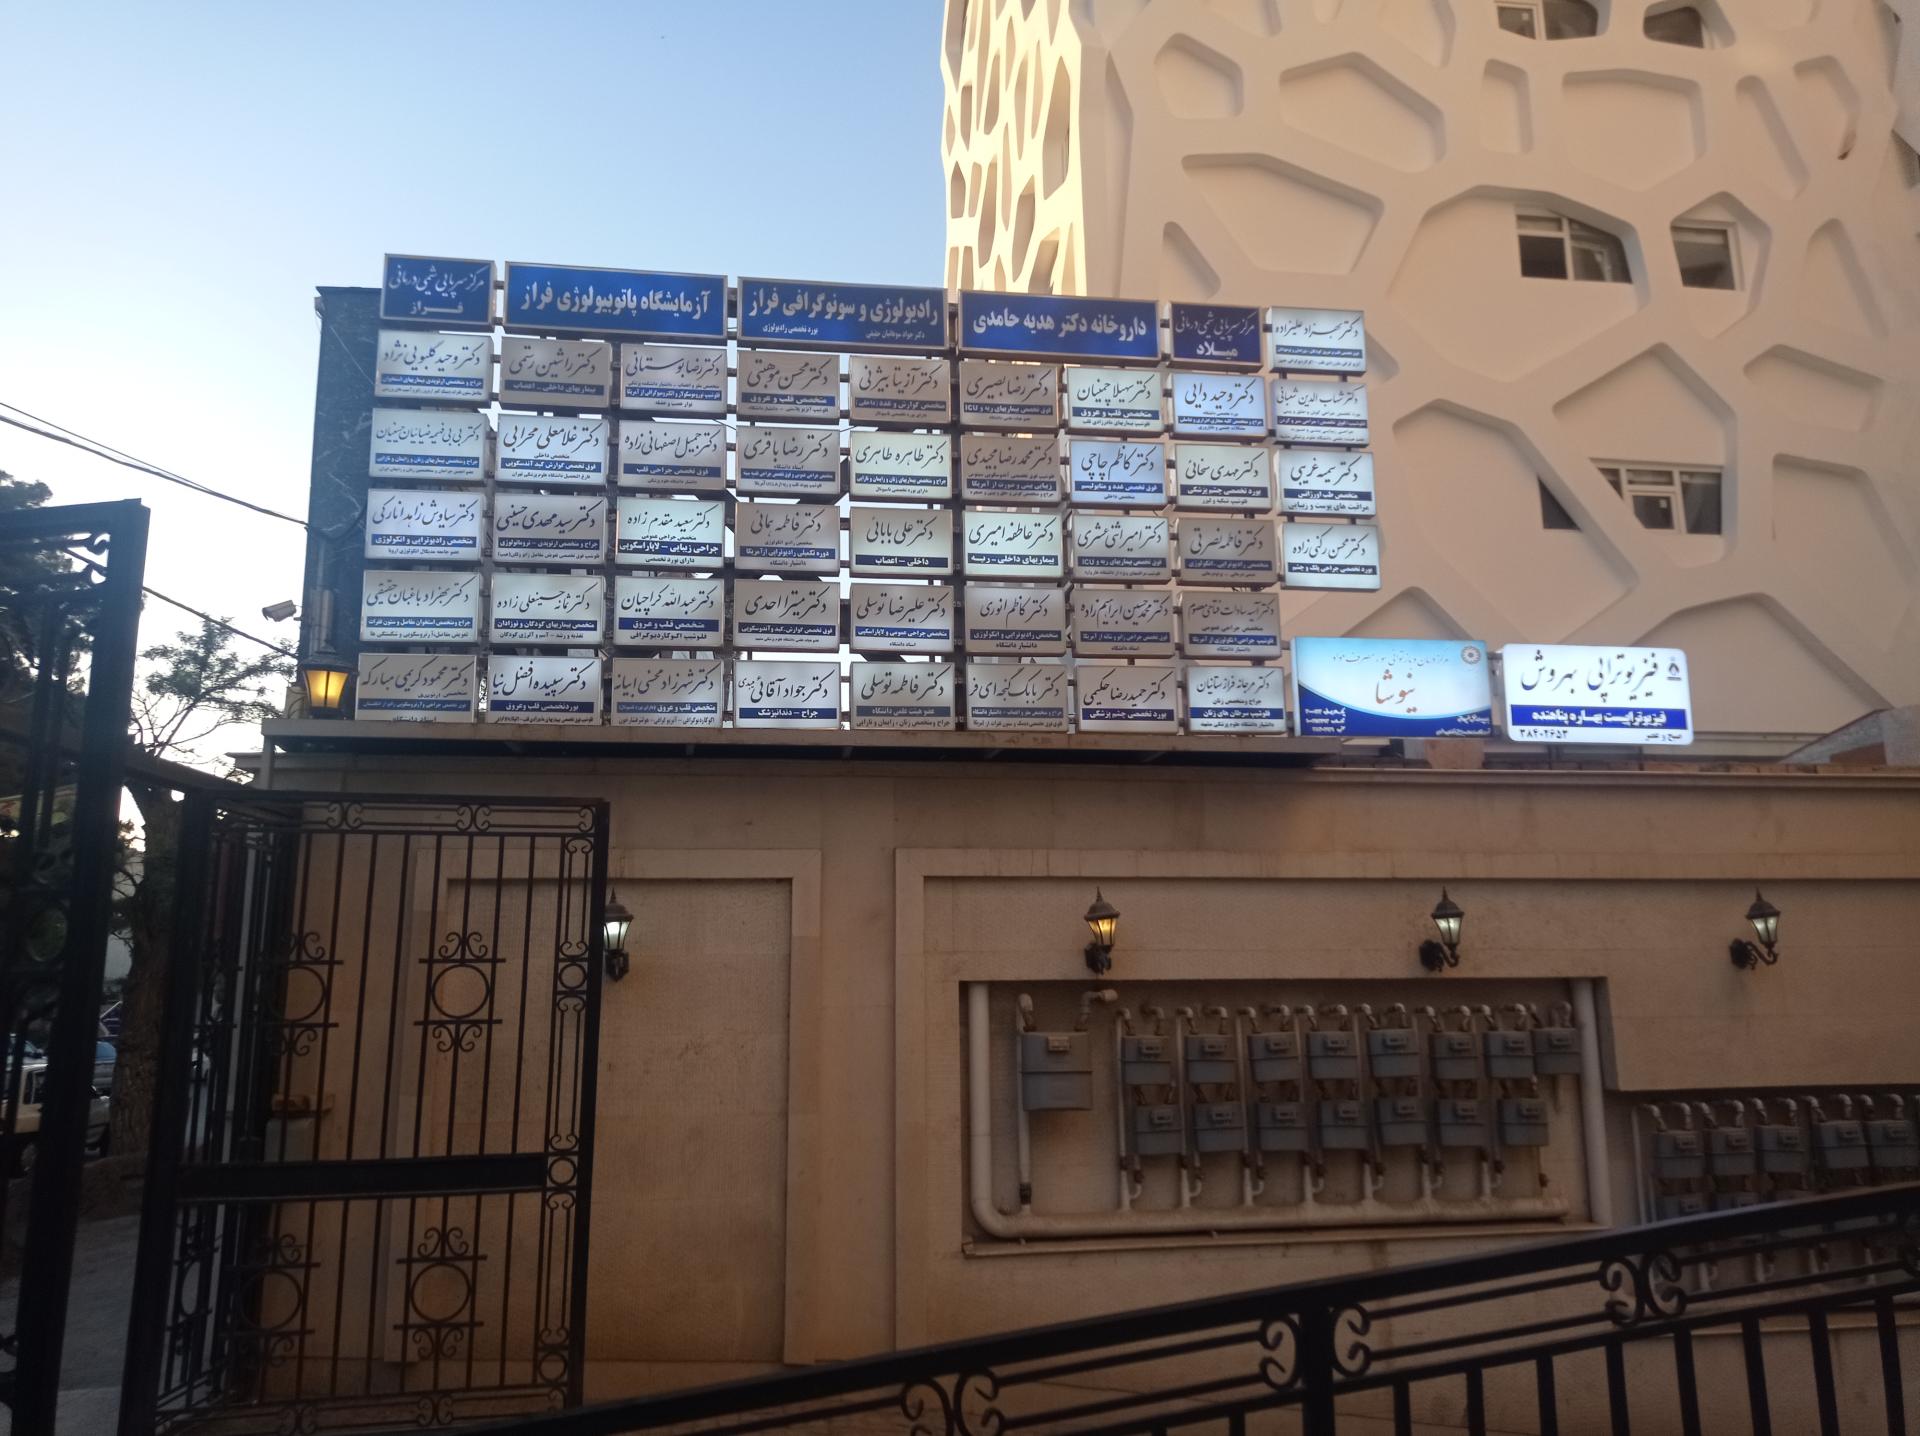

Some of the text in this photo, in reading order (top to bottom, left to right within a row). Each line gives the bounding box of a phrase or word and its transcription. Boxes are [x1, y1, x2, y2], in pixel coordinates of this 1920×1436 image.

[520, 282, 711, 320] آزمایشگاه پاتوبیولوژی فراز
[749, 288, 938, 325] رادیولوژی و سونوگرافی فراز
[973, 308, 1147, 341] داروخانه دکتر هدیه حامدی
[509, 345, 602, 378] دکتر راشین رستمی
[626, 352, 722, 380] دکتر رضا بوستانی
[747, 358, 831, 390] دکتر محسن موهبتی
[859, 364, 943, 394] دکتر آزیتا بیژنی
[967, 368, 1051, 402] دکتر رضا بصیری
[1077, 374, 1155, 406] دکتر سهیلا چمنیان
[1229, 379, 1255, 409] دکتر
[1081, 409, 1101, 417] عروق
[1210, 390, 1232, 409] وحید
[503, 423, 603, 453] دکتر غلامعلی محرابی
[625, 429, 721, 458] دکتر جمیل اصفهانی زاده
[744, 432, 833, 464] دکتر رضا باقری
[855, 441, 947, 469] دکتر طاهره طاهری
[1081, 445, 1157, 481] دکتر کاظم چاچی
[1236, 452, 1264, 480] دکتر
[1211, 465, 1239, 480] مهدی
[1291, 456, 1362, 486] دکتر سمیه غریبی
[628, 504, 718, 532] دکتر سعید مقدم زاده
[906, 516, 937, 546] دکتر
[969, 517, 1056, 549] دکتر عاطفه امیری
[376, 536, 405, 544] انکولوژی
[411, 536, 449, 545] رادیوتراپی
[620, 542, 718, 554] جراحی زیبایی لاپاراسکوپی
[894, 524, 913, 544] علی
[875, 557, 929, 566] داخلی اعصاب
[998, 555, 1020, 563] داخلی
[1022, 556, 1054, 564] بیماریهای
[621, 584, 718, 615] دکتر عبدالله کراچیان
[745, 586, 830, 619] دکتر میترا احدی
[856, 592, 949, 624] دکتر علیرضا توسلی
[980, 594, 1049, 628] دکتر کاظم انوری
[524, 620, 545, 628] کودکان
[493, 661, 594, 696] دکتر سپیده افضل نیا
[738, 677, 755, 689] میبدی
[802, 670, 835, 702] دکتر
[861, 664, 951, 701] دکتر فاطمه توسلی
[1521, 649, 1658, 703] فیزیوتراپی بهروش
[783, 685, 805, 698] جواد
[758, 709, 818, 718] جراح دندانپزشک
[1089, 710, 1110, 719] پزشکی
[1128, 711, 1152, 719] تخصصی
[1532, 709, 1667, 727] فیزیوتراپیست بهاره پناهنده
